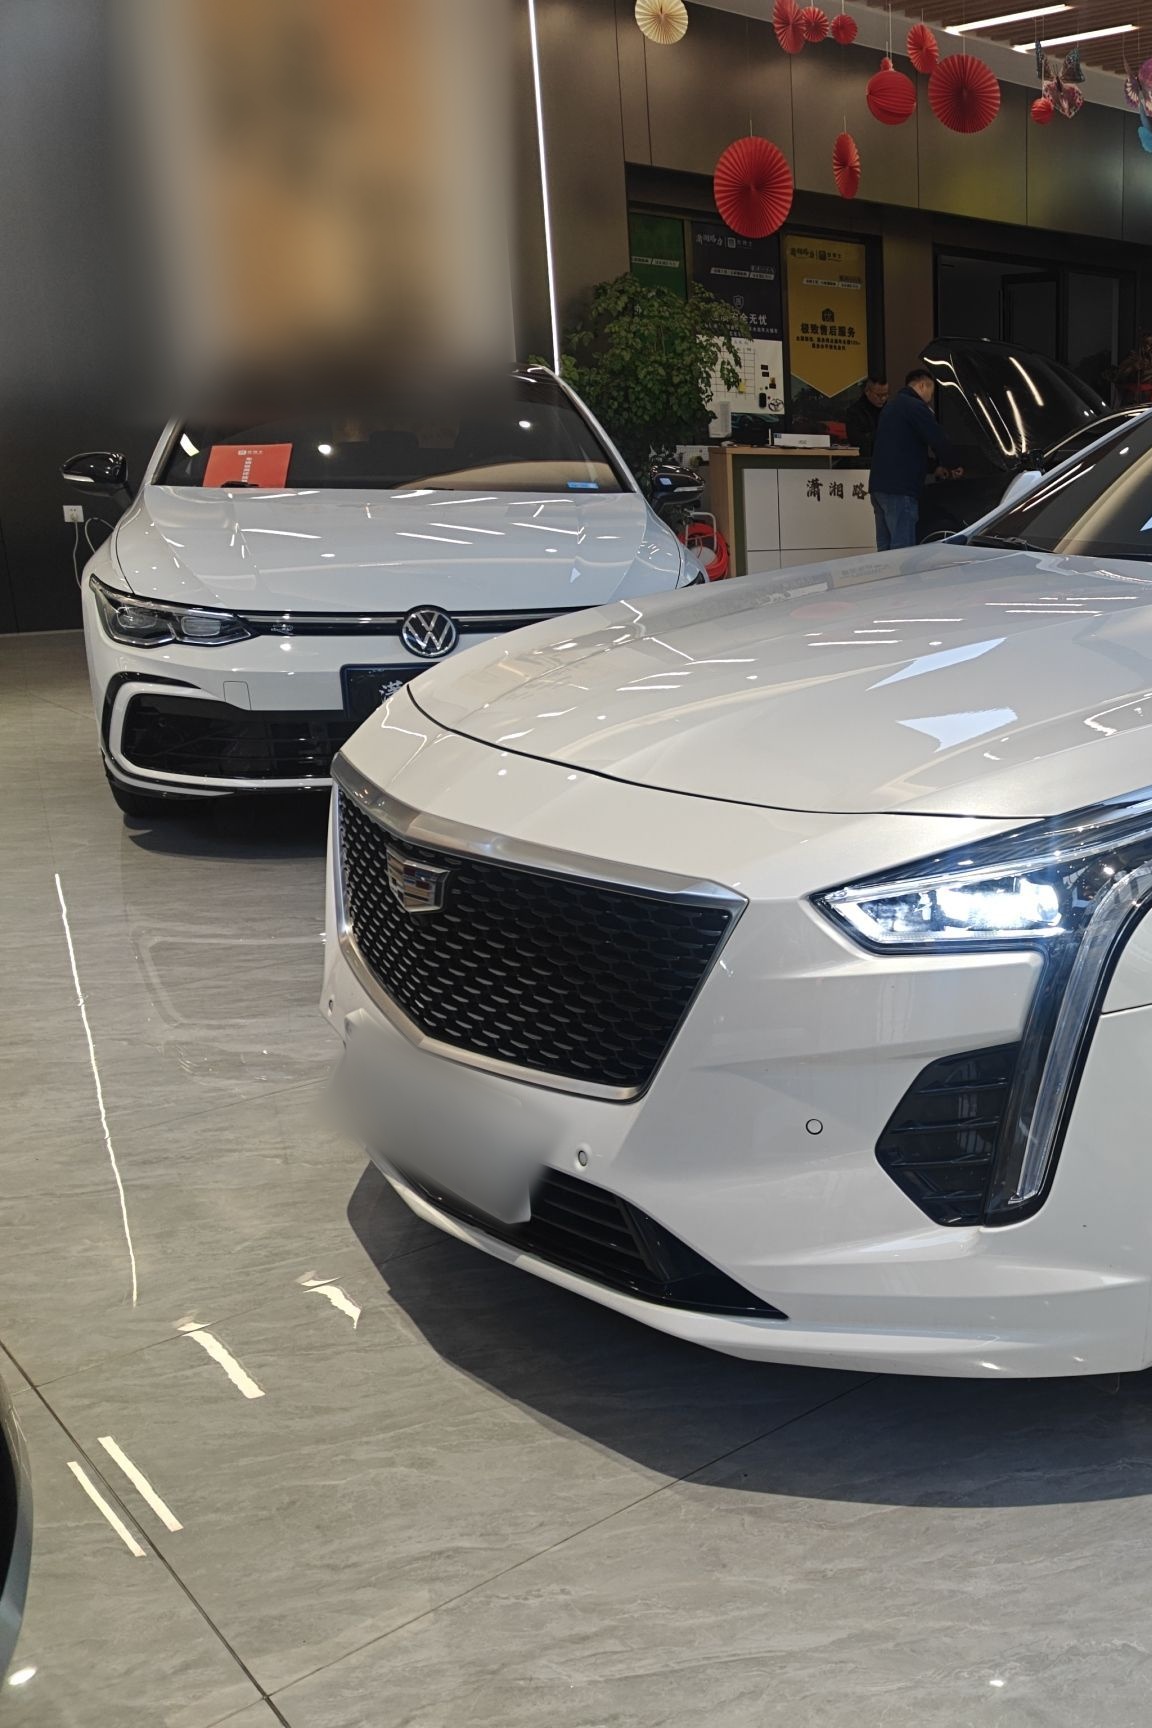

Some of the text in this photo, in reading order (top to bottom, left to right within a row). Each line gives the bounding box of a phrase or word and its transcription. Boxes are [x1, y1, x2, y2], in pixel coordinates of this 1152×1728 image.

[800, 323, 856, 338] 极致售后服务
